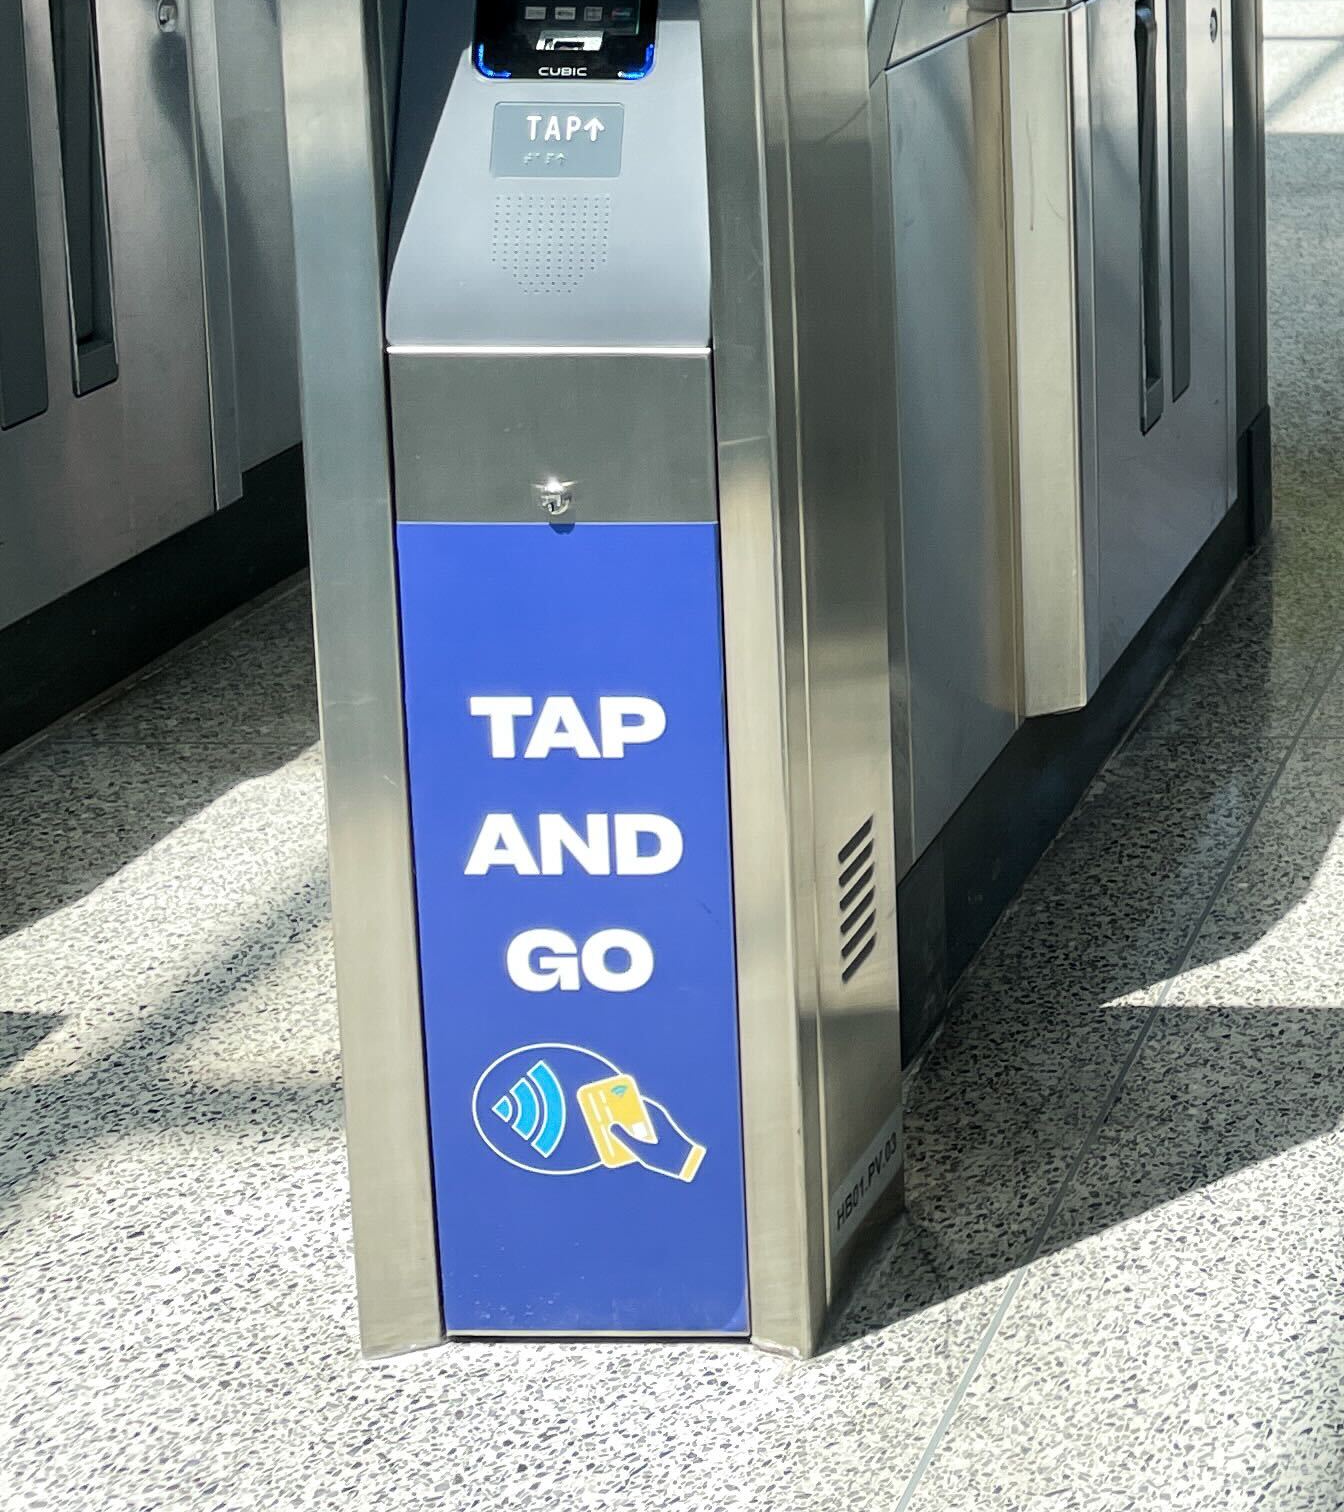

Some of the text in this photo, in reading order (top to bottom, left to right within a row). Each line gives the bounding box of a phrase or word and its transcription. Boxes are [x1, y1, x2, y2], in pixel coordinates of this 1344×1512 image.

[538, 66, 588, 77] CUBIC
[526, 115, 582, 142] TAP
[469, 695, 667, 759] TAP
[463, 813, 684, 876] AND
[506, 928, 654, 992] GO
[836, 1131, 898, 1230] HB01.PV.03
